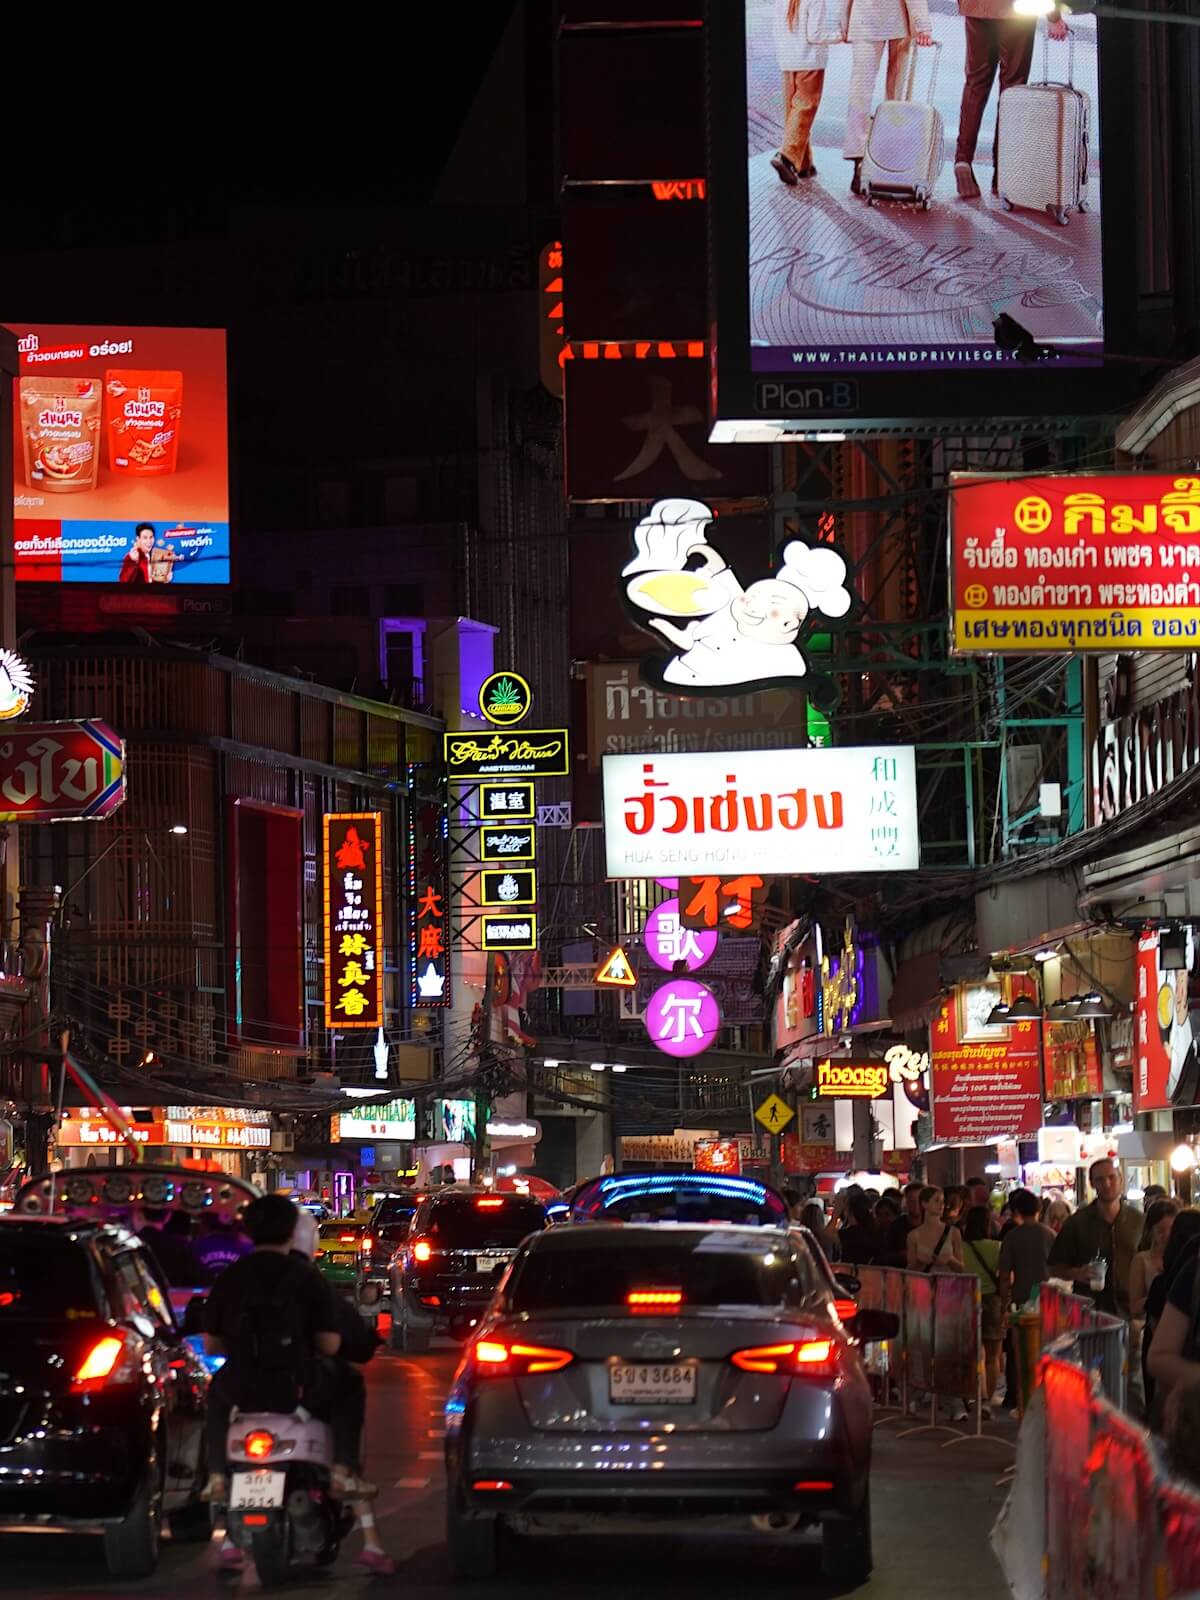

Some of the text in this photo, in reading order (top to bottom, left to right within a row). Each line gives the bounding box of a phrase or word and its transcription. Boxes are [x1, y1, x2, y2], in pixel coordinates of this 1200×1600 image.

[90, 340, 132, 357] อร่อย!
[963, 528, 1018, 568] รับซื้อ
[1024, 539, 1097, 568] ทองเก่า
[1104, 545, 1152, 567] เพชร
[993, 574, 1091, 606] ทองคำขาว
[964, 612, 1142, 646] เศษทองทุกชนิด
[479, 763, 535, 773] AMSTERDAM
[624, 849, 653, 863] HUA
[659, 848, 698, 862] SENG
[334, 933, 372, 1016] 林真香
[818, 1059, 888, 1085] ที่จอดรถ
[652, 1367, 691, 1384] 3684
